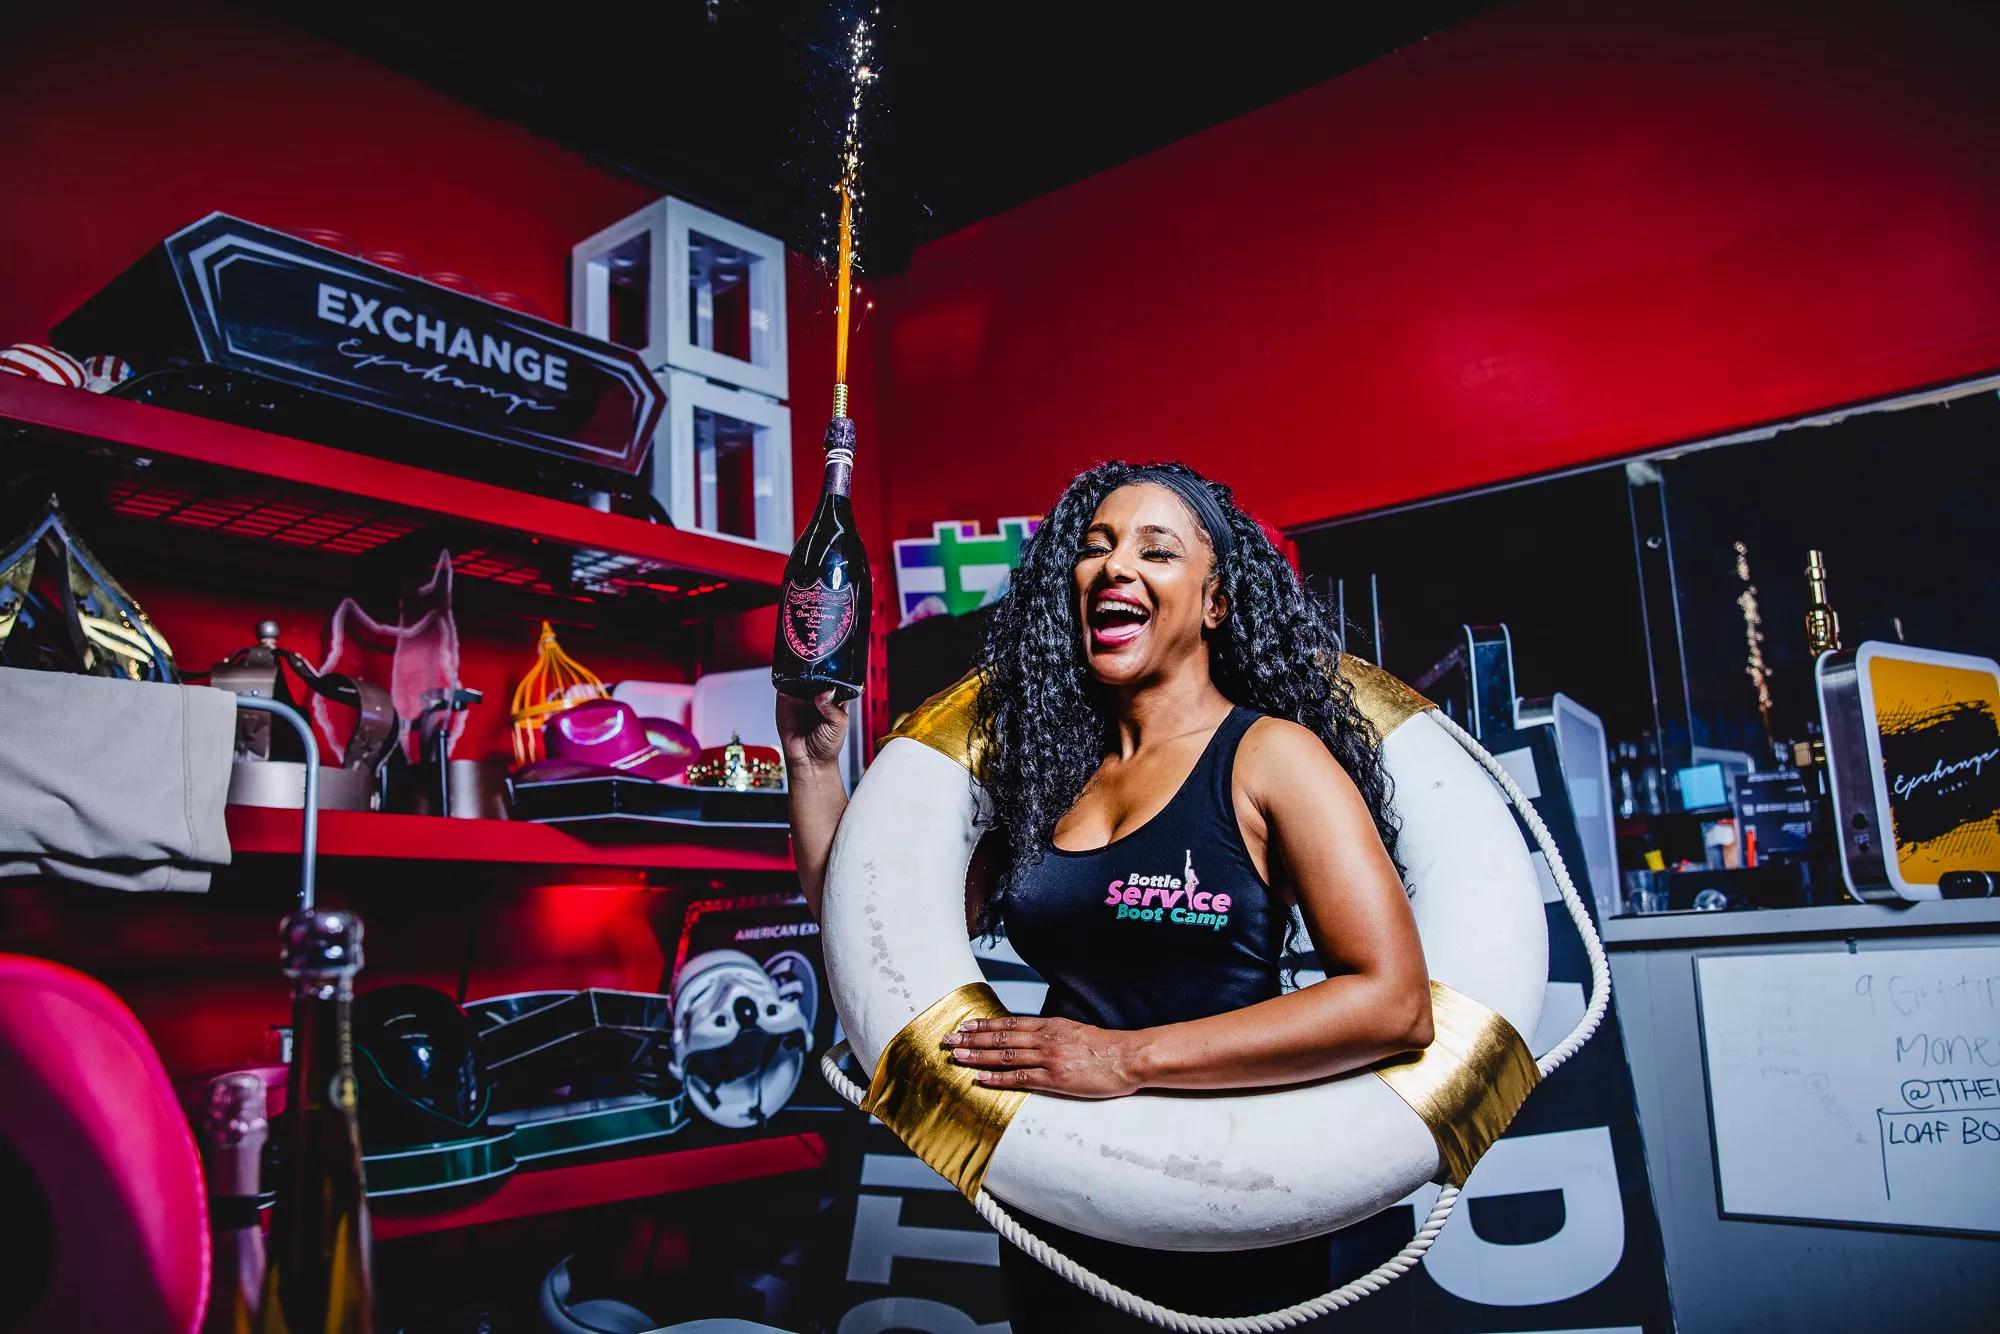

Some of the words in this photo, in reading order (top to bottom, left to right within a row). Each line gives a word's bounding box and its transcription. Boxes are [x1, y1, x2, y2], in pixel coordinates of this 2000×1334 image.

[317, 282, 568, 391] EXCHANGE
[1894, 748, 1999, 801] Exchange
[1105, 868, 1233, 913] Service
[1128, 873, 1181, 889] Bottle
[735, 924, 799, 941] AMERICAN
[1117, 903, 1164, 921] Boot
[1170, 907, 1229, 932] Camp
[1896, 1033, 2000, 1068] Mone
[1901, 1078, 2000, 1110] @TTHE
[1889, 1120, 1949, 1145] LOAF
